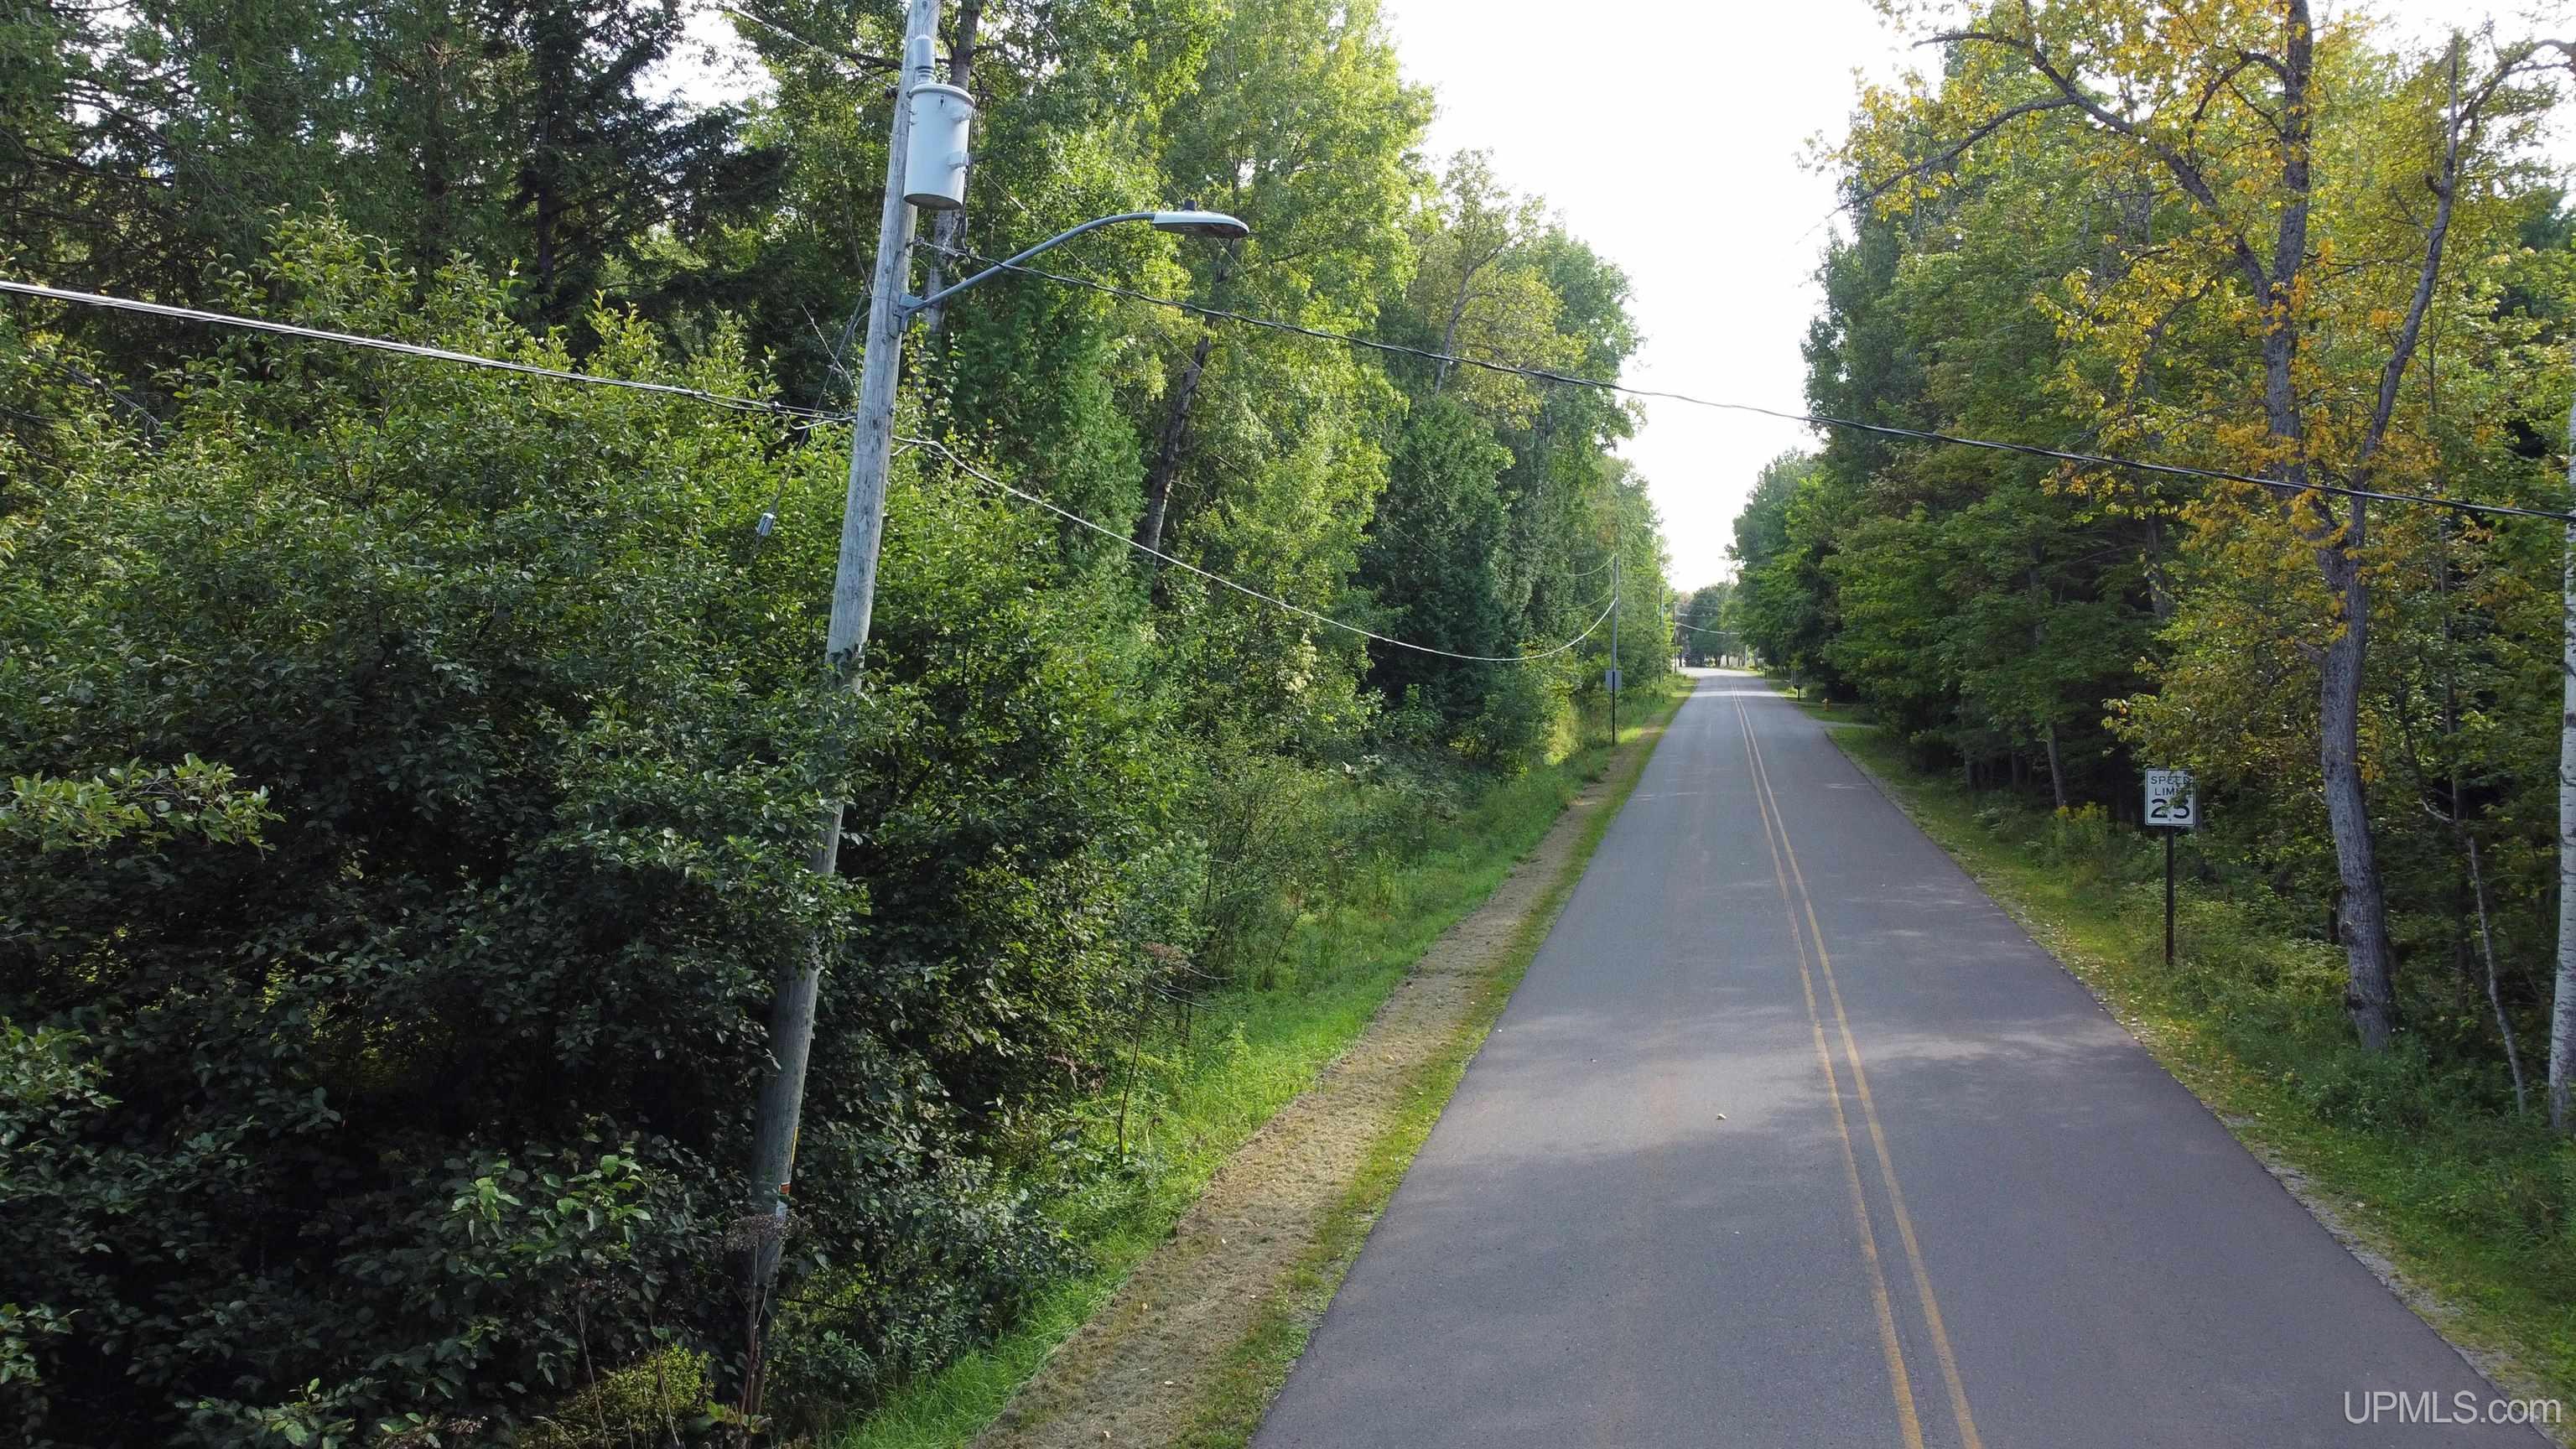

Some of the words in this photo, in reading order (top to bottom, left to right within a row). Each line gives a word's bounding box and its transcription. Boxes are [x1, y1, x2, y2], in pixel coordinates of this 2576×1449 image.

[2150, 776, 2191, 785] SPEED
[2154, 787, 2184, 796] LIM
[2151, 798, 2190, 819] 25
